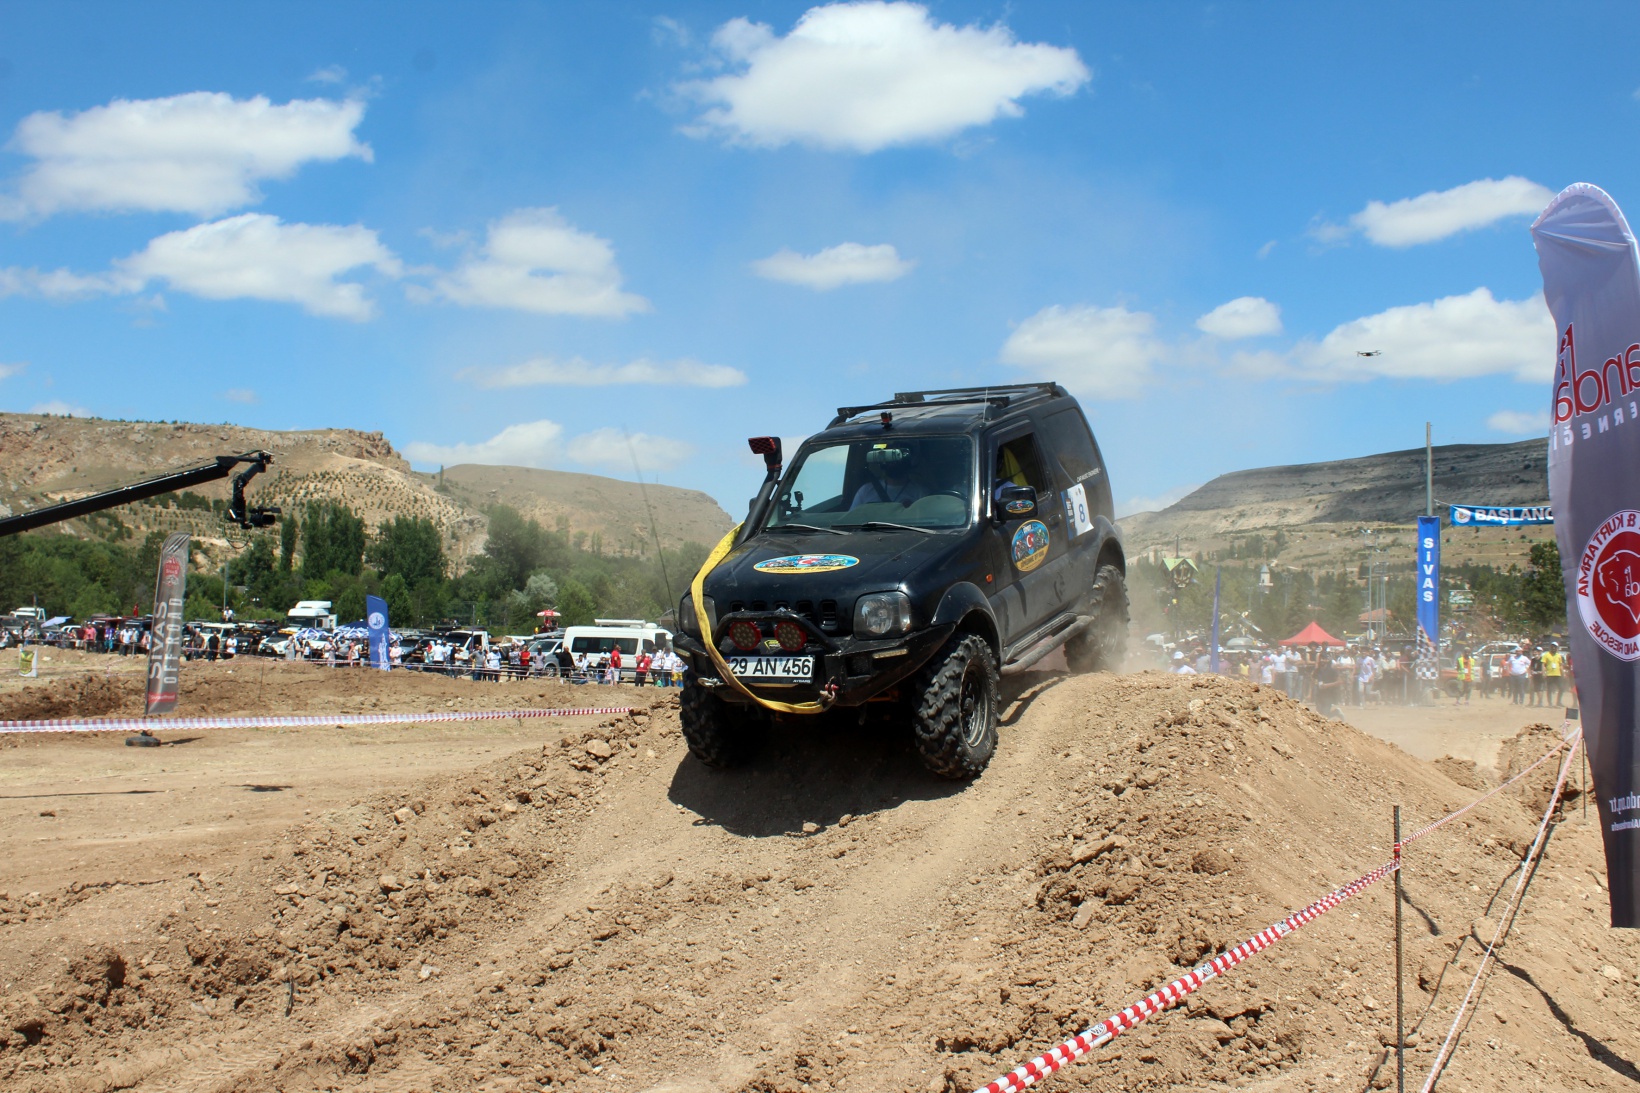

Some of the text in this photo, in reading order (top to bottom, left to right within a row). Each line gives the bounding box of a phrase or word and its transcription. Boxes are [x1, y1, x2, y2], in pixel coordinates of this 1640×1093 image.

[1079, 503, 1086, 523] 8
[730, 657, 811, 676] 29 AN 456
